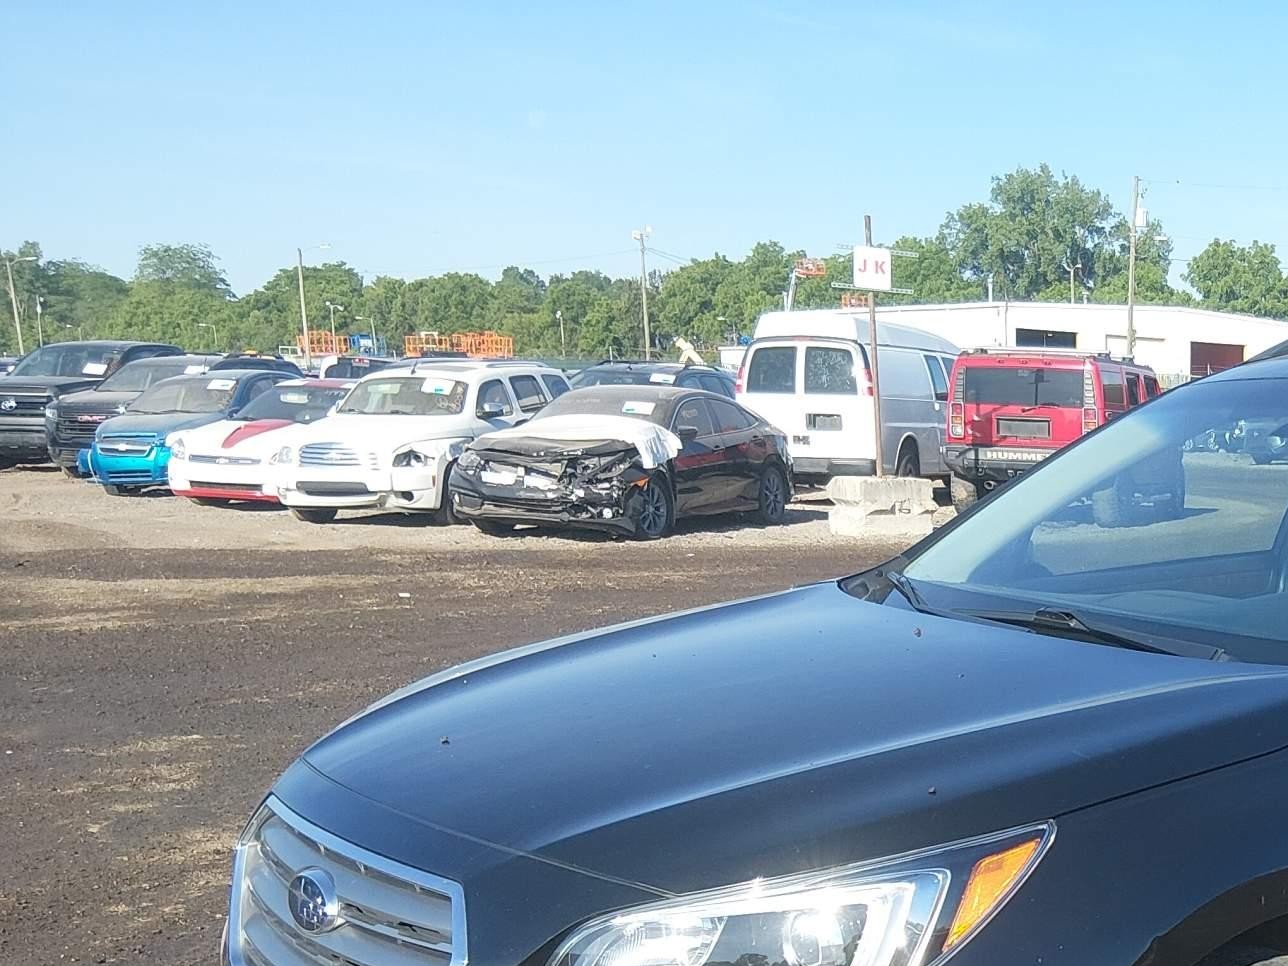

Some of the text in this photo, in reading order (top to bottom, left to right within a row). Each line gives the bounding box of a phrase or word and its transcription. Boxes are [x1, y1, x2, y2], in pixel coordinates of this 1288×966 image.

[858, 259, 887, 275] J K
[986, 451, 1050, 461] HUMME
